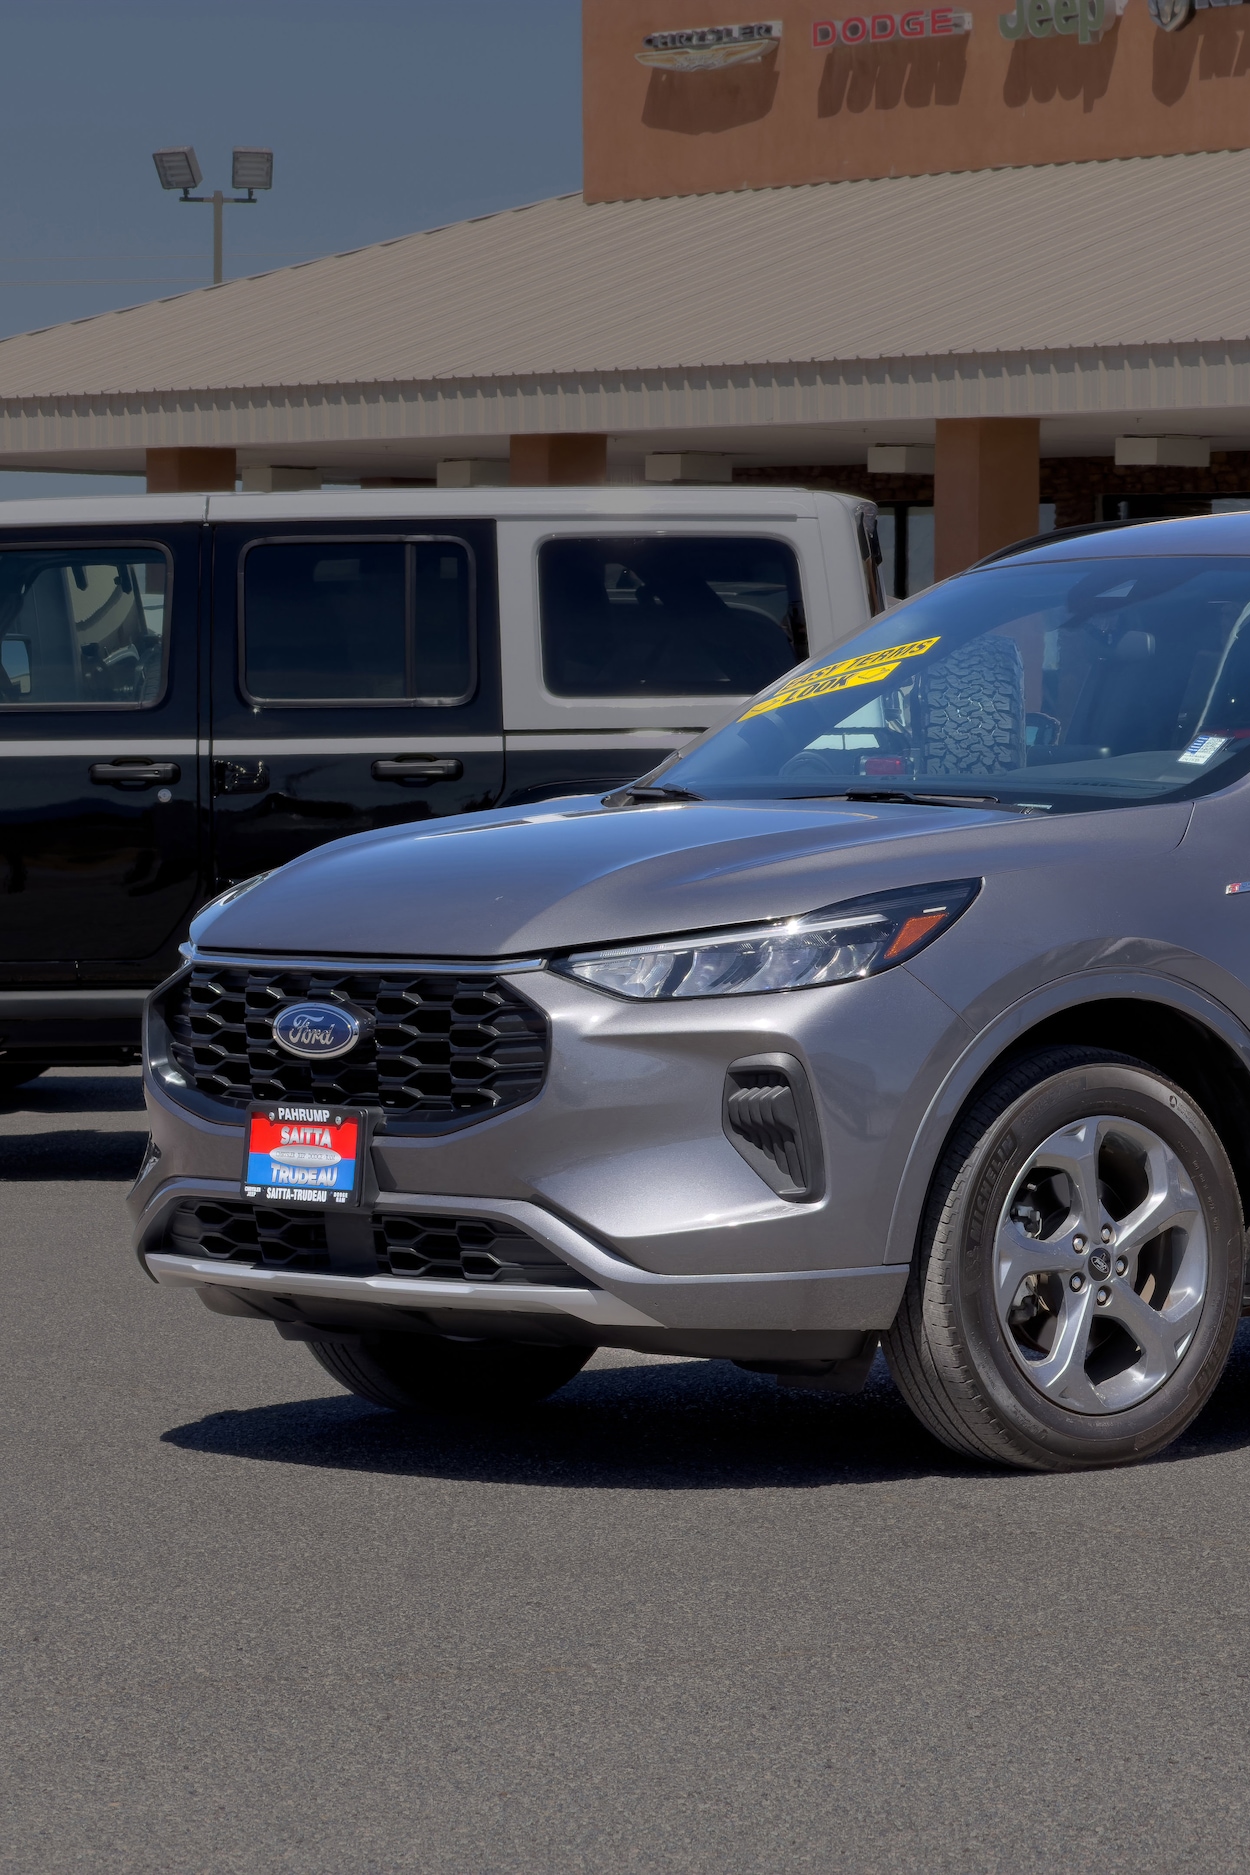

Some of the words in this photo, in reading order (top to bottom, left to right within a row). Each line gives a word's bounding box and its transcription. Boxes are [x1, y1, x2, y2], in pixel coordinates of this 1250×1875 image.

[811, 7, 955, 48] DODGE
[846, 639, 933, 670] TERMS
[780, 672, 855, 705] LOOK
[288, 1013, 335, 1046] Ford
[278, 1107, 330, 1123] PAHRUMP
[280, 1126, 332, 1148] SAITTA
[270, 1162, 338, 1187] TRUDEAU
[969, 1133, 1018, 1242] MICHELIN
[266, 1187, 327, 1202] SAITTA-TRUDEAU
